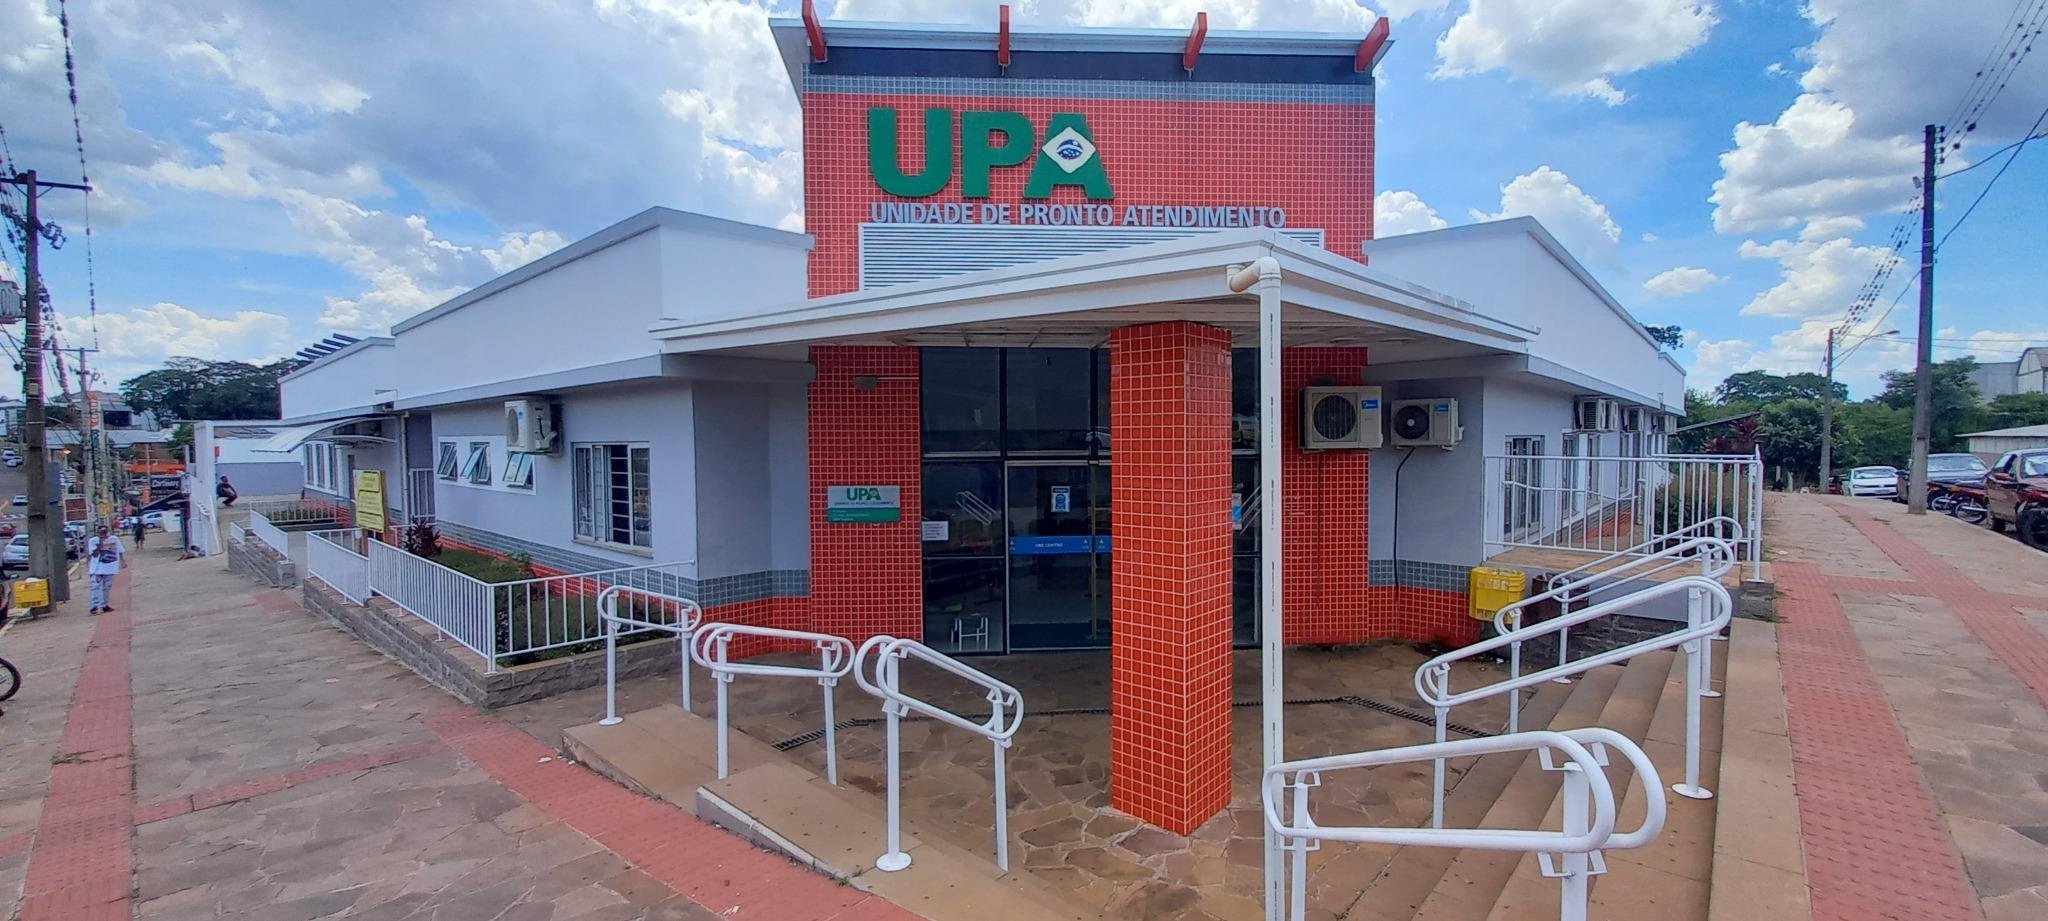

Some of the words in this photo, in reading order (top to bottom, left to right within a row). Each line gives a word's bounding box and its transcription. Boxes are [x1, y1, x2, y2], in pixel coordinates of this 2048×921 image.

[868, 107, 1114, 199] UPA
[871, 202, 974, 223] UNIDADE
[981, 203, 1011, 224] DE
[1020, 204, 1114, 226] PRONTO
[1122, 205, 1287, 228] ATENDIMENTO
[846, 487, 881, 501] UPA
